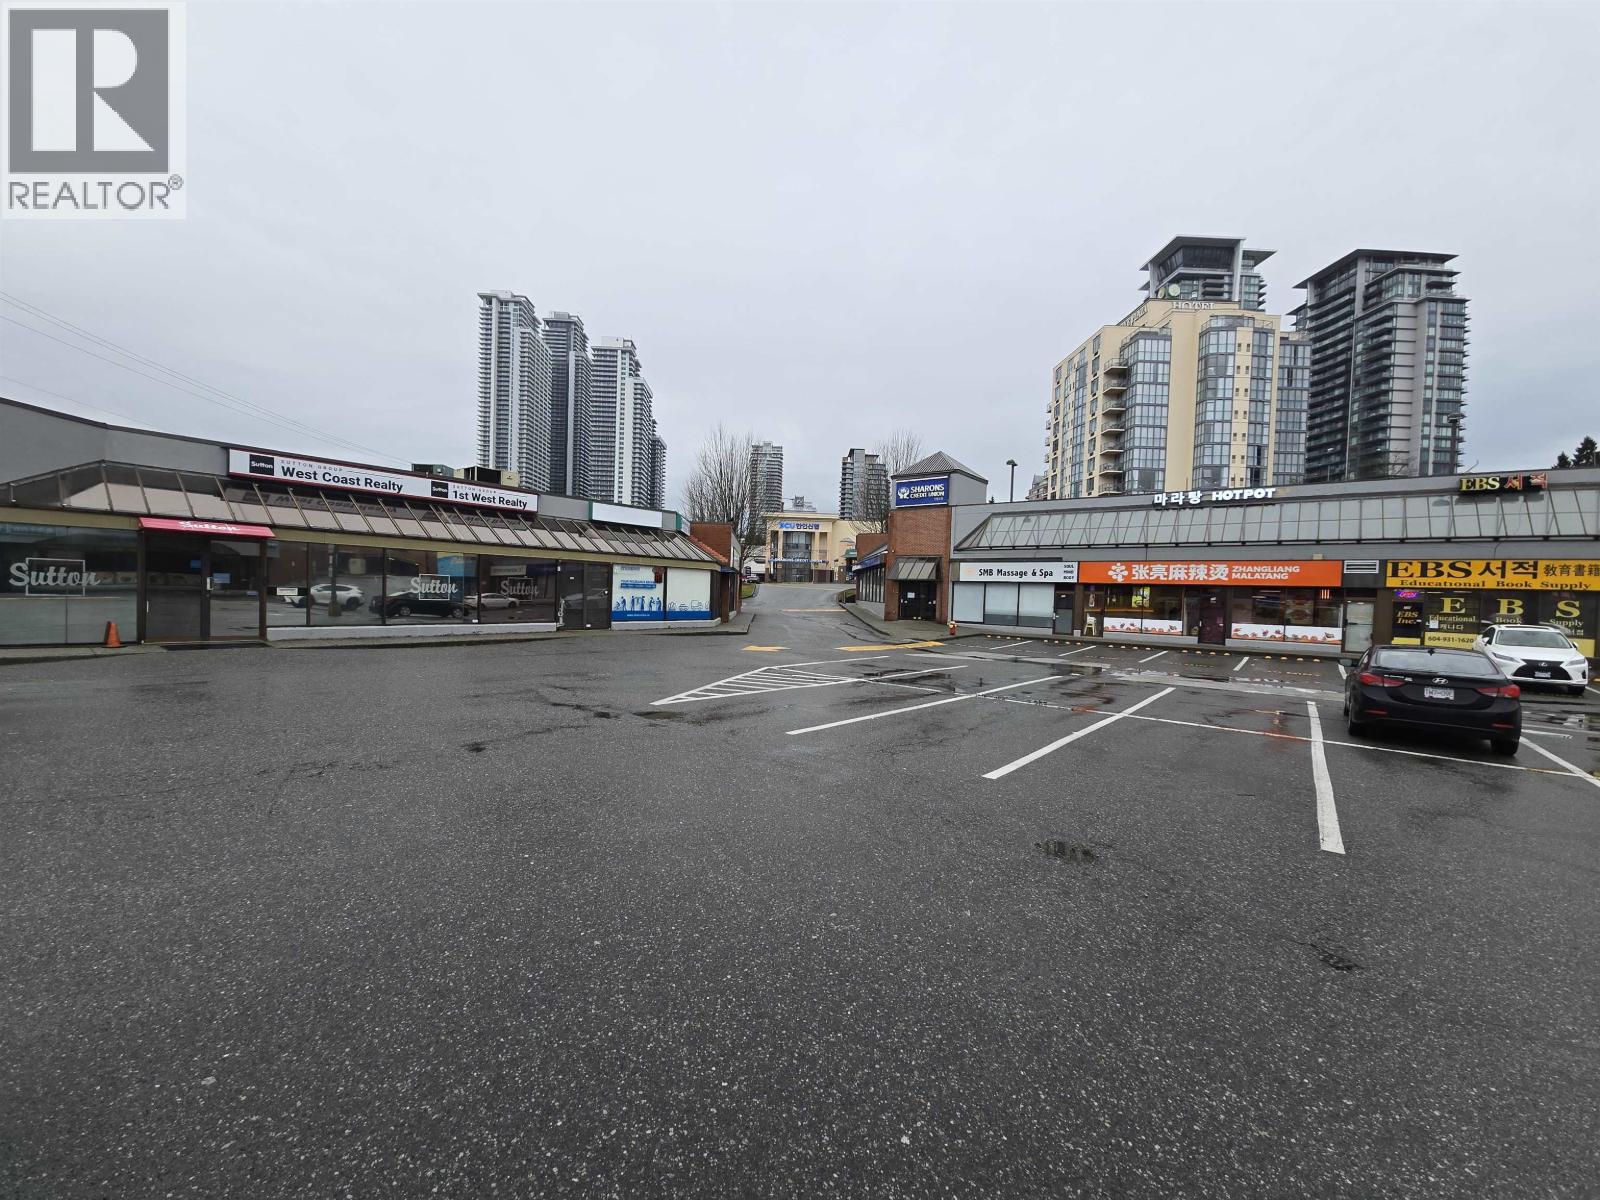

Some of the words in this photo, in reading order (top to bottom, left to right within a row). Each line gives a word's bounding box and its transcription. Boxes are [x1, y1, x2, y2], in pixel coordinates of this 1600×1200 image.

[1173, 301, 1214, 310] HOTEL
[250, 460, 273, 469] Sutton
[280, 459, 313, 468] SUTTON
[317, 464, 343, 472] GROUP
[281, 465, 318, 480] West
[322, 471, 361, 486] Coast
[364, 477, 403, 494] Realty
[1460, 476, 1500, 491] EBS
[909, 491, 927, 499] CREDIT
[927, 490, 945, 498] UNION
[910, 483, 945, 494] SHARONS
[452, 490, 469, 501] 1st
[471, 492, 497, 505] West
[498, 497, 528, 510] Realty
[1153, 490, 1203, 506] 마라탕
[1211, 487, 1276, 501] HOTPOT
[179, 520, 241, 533] Sutton
[9, 562, 101, 587] Sutton
[978, 568, 994, 577] SMB
[996, 568, 1028, 578] Massage
[1031, 568, 1037, 577] &
[1039, 568, 1054, 579] Spa
[1131, 563, 1229, 581] 张亮麻辣烫
[1231, 565, 1300, 573] ZHANGLIANG
[1231, 572, 1289, 580] MALATANG
[1387, 560, 1473, 579] EBS
[1478, 560, 1539, 580] 서적
[410, 576, 459, 594] Sutton
[500, 580, 540, 596] Sutton
[1399, 579, 1486, 588] Educational
[1495, 580, 1533, 588] Book
[1539, 581, 1592, 591] Supply
[1440, 597, 1466, 614] E
[1496, 598, 1524, 615] B
[1555, 600, 1581, 618] S
[1429, 614, 1476, 623] Educational
[1495, 616, 1523, 624] Book
[1549, 618, 1584, 628] Supply
